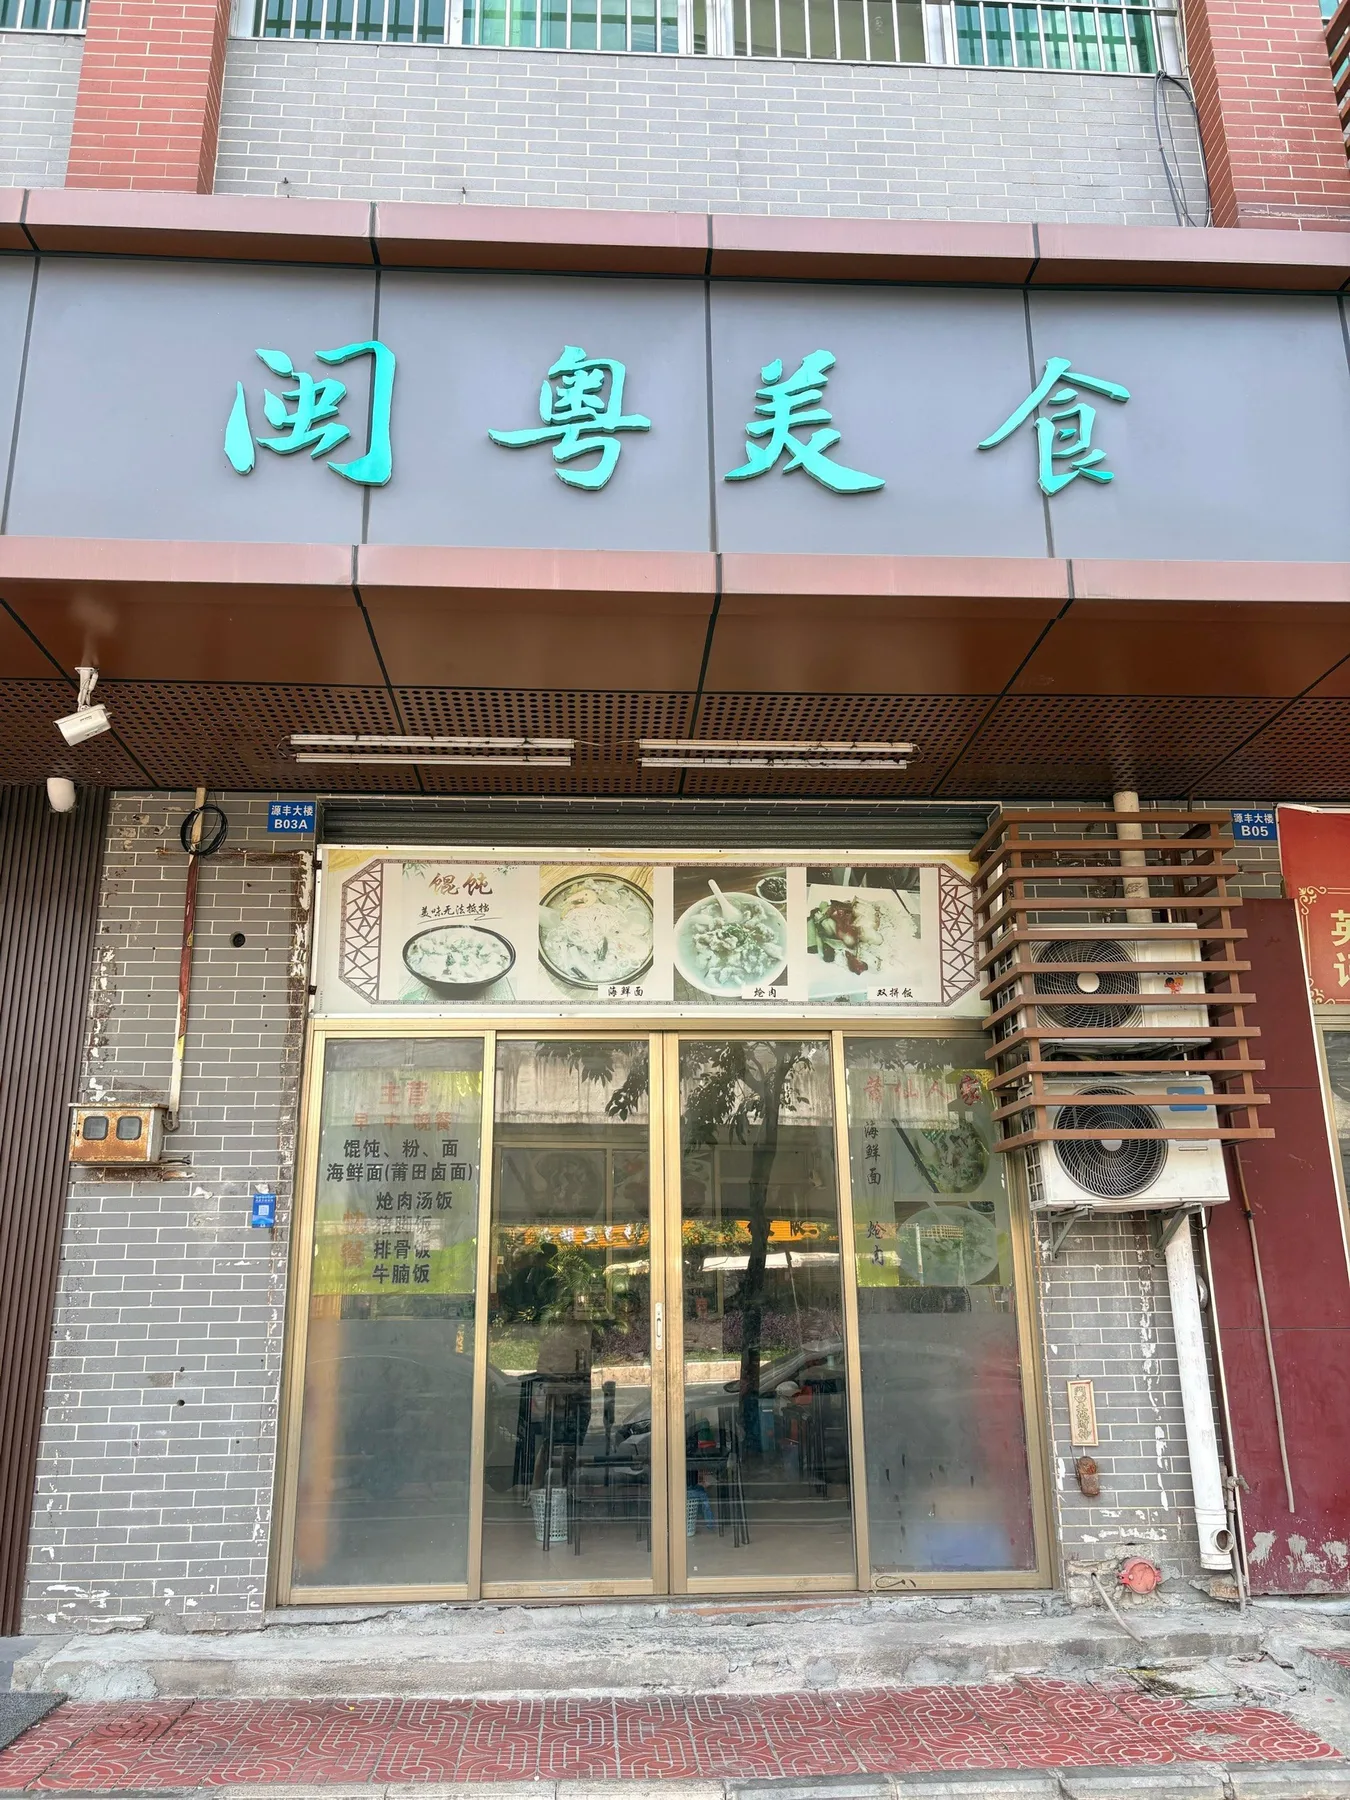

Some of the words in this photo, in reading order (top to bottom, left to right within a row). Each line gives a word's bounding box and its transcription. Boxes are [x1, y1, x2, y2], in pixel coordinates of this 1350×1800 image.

[224, 340, 1131, 498] 闽粤美食
[271, 805, 314, 817] 源丰大楼
[1233, 813, 1274, 824] 源丰大楼
[274, 818, 308, 829] B03A
[1241, 825, 1269, 837] B05
[428, 872, 493, 896] 馄饨
[419, 902, 490, 918] 美味无法抵挡
[607, 985, 644, 998] 海鲜面
[876, 987, 914, 999] 双拼饭
[379, 1081, 428, 1106] 主营
[863, 1120, 881, 1186] 海鲜面
[326, 1162, 474, 1182] 海鲜面(莆田卤面)
[373, 1239, 431, 1259] 排骨饭
[372, 1263, 430, 1284] 牛腩饭
